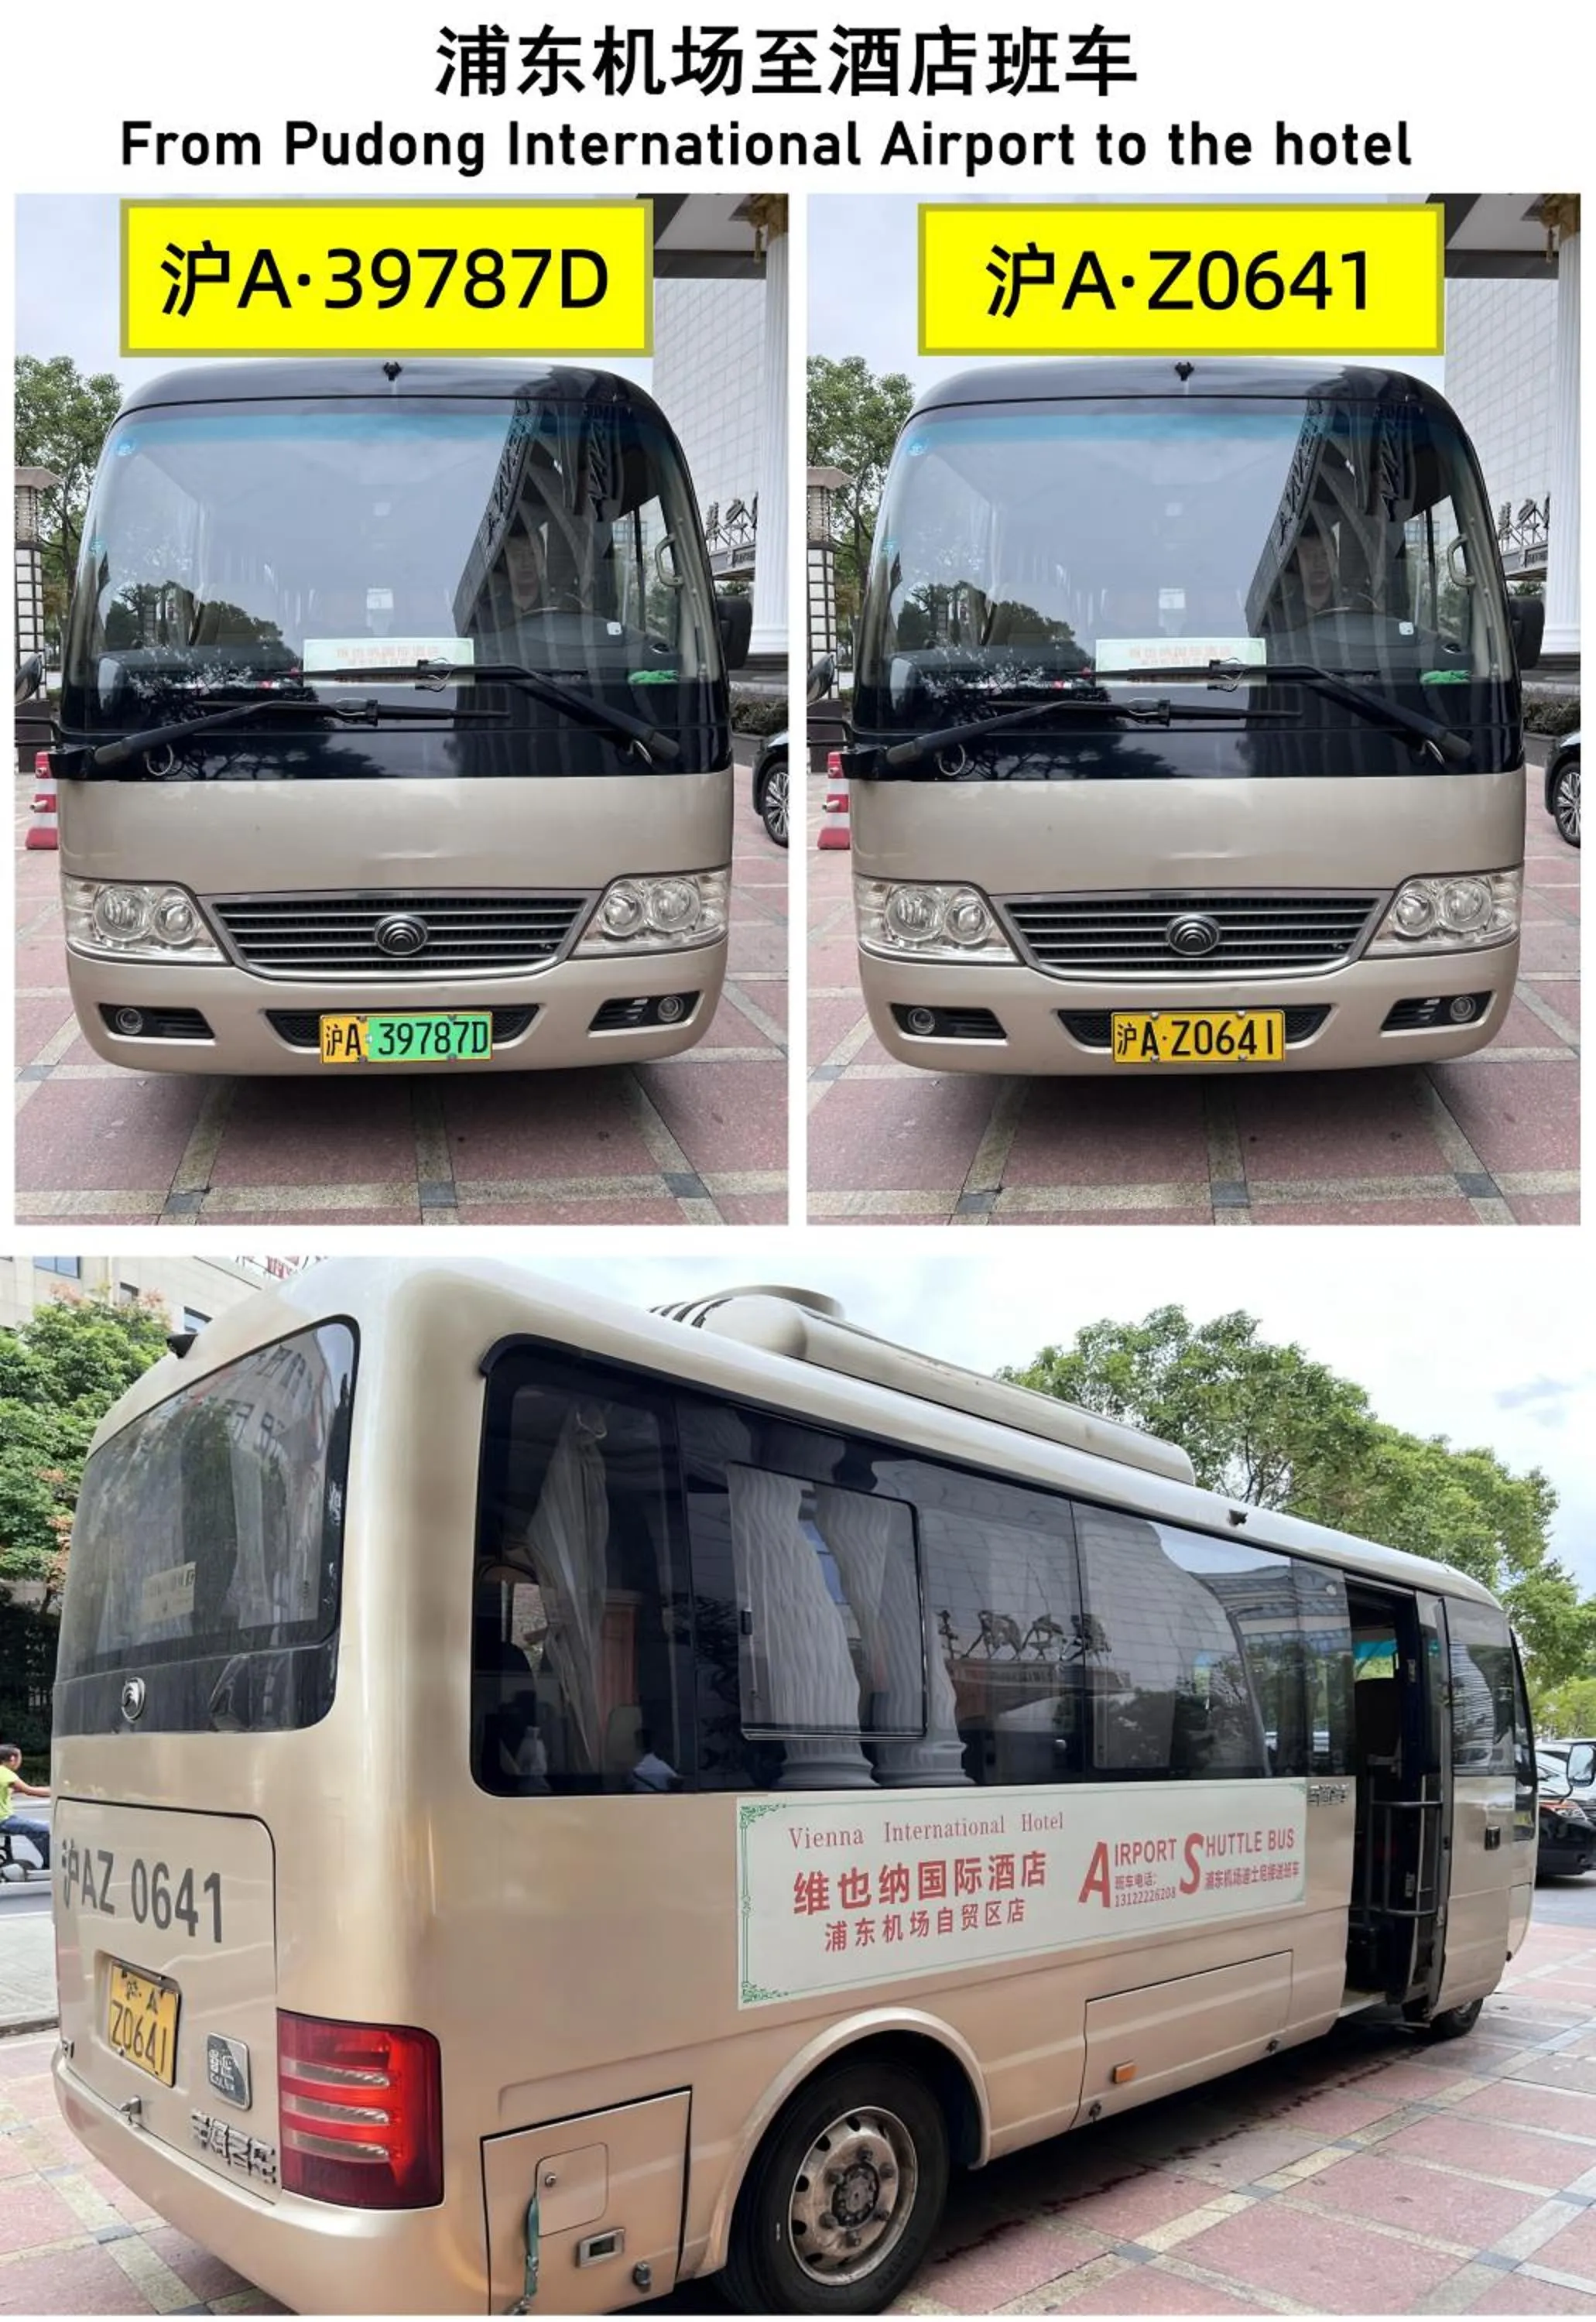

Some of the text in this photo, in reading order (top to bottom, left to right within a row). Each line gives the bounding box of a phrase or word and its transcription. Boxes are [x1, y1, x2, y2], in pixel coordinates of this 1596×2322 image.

[789, 1812, 1063, 1848] Vienna International Hotel
[1267, 1827, 1295, 1851] BUS
[131, 1858, 222, 1943] 0641
[793, 1851, 1046, 1916] 维也纳国际酒店
[825, 1897, 1026, 1952] 浦东机场自贸区店
